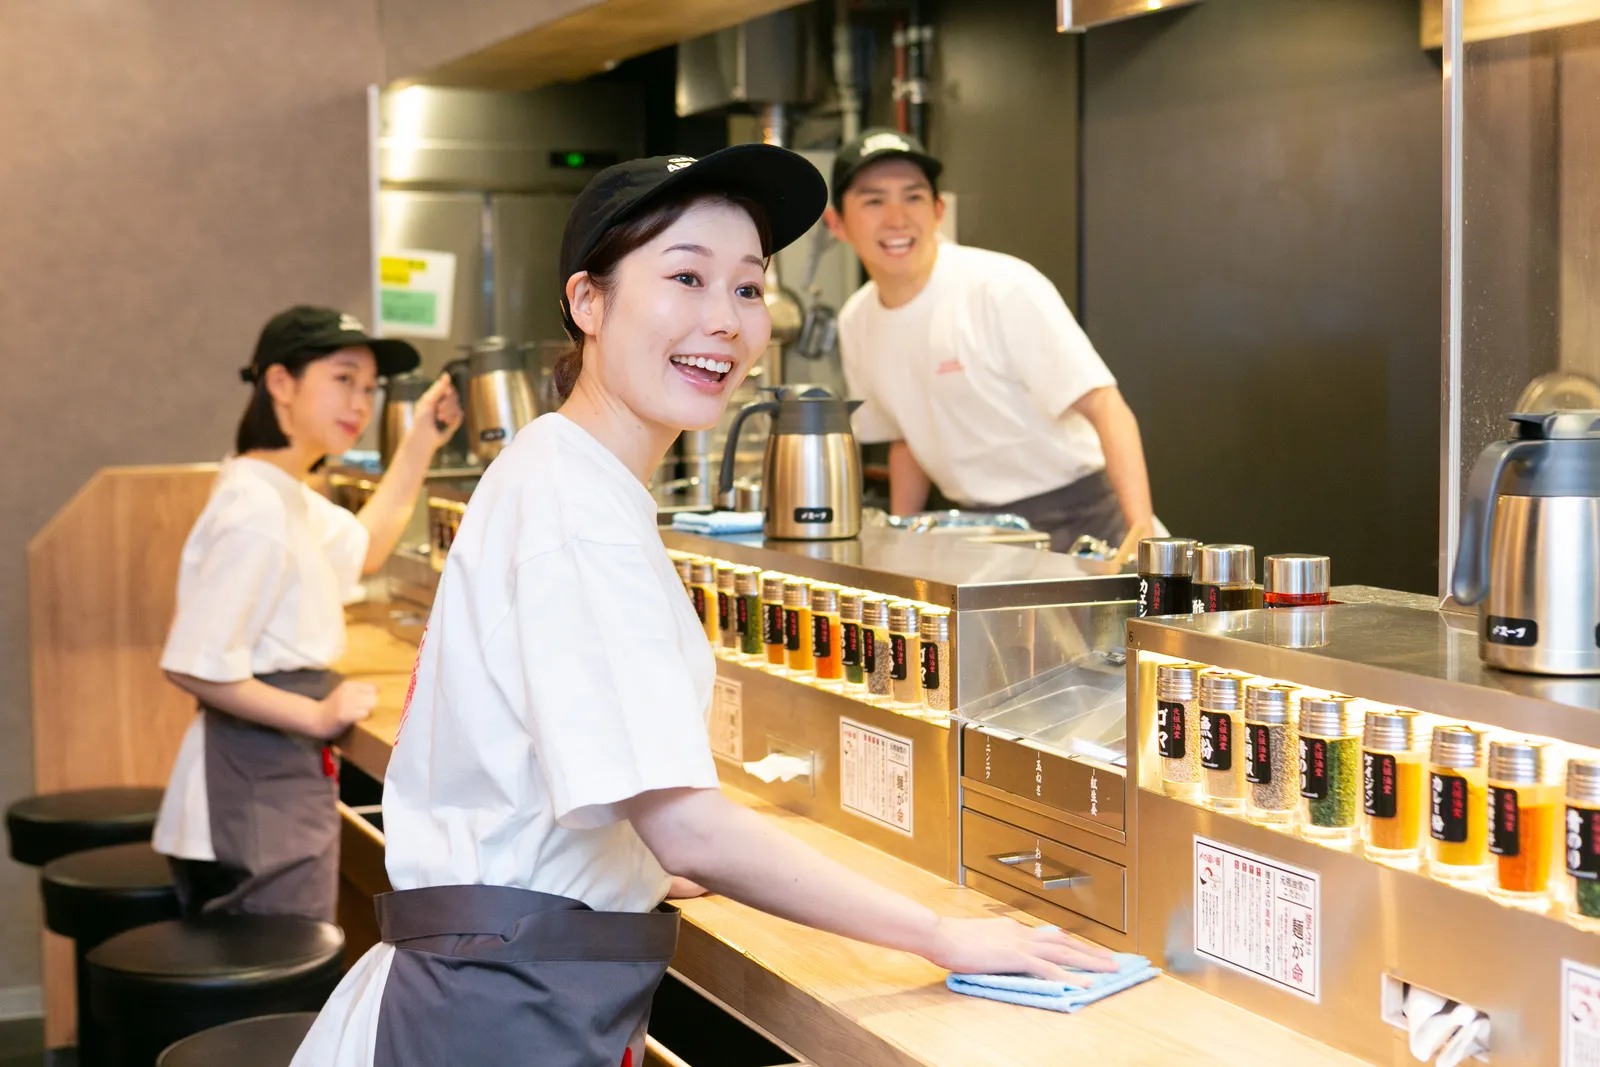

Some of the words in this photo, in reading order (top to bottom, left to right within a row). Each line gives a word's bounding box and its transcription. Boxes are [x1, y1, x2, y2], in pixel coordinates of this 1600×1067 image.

[1128, 631, 1134, 642] 6
[1292, 917, 1304, 984] 麺が命
